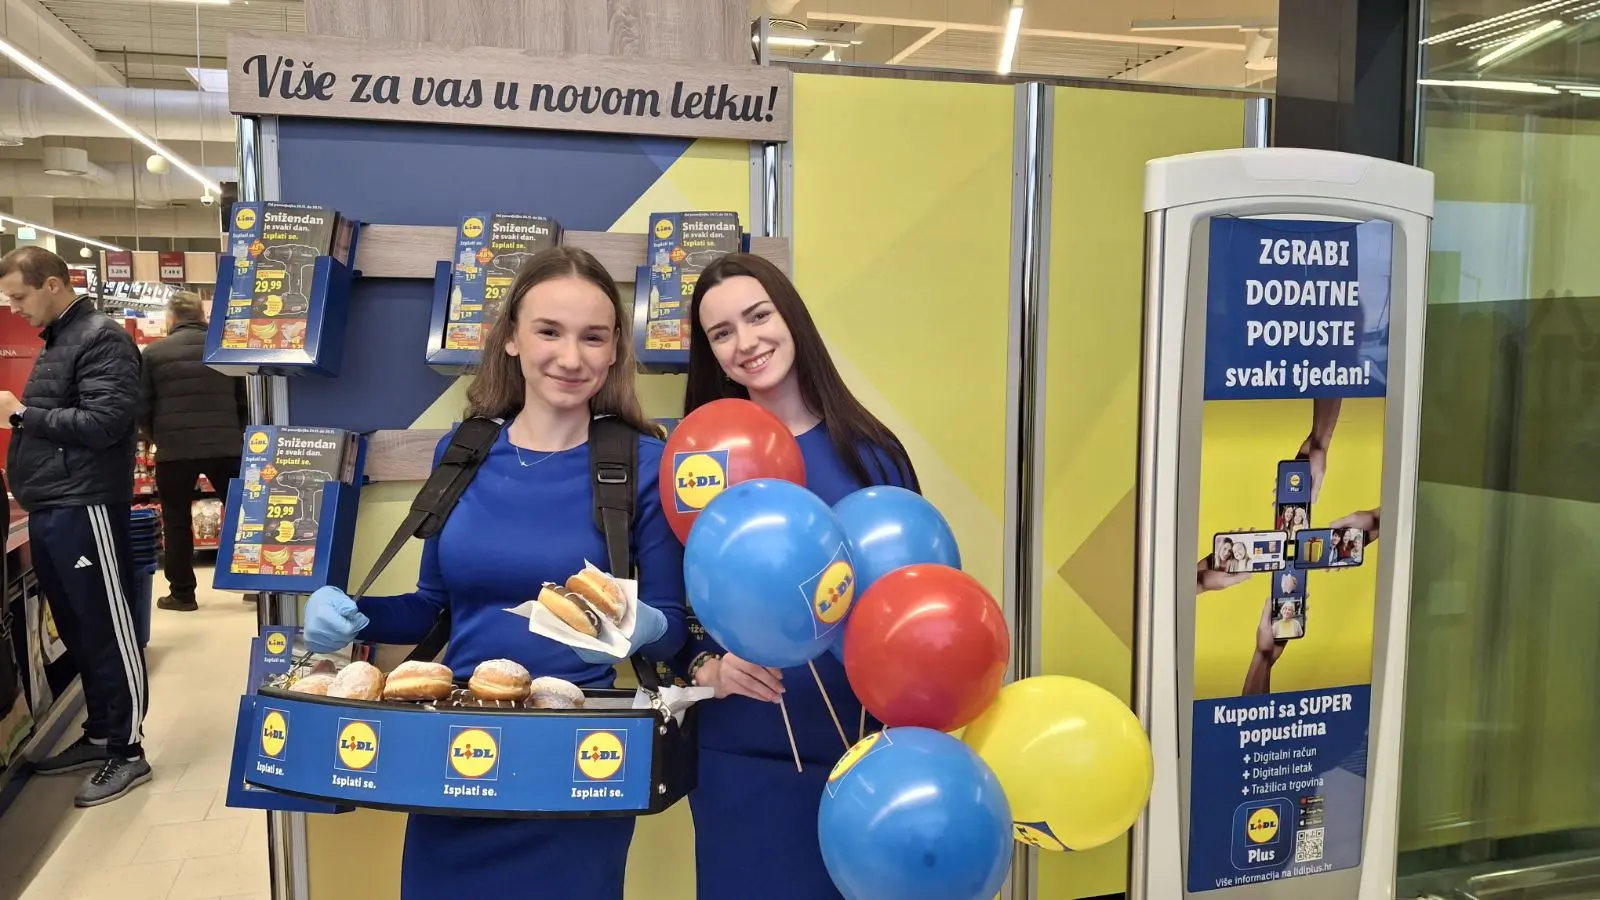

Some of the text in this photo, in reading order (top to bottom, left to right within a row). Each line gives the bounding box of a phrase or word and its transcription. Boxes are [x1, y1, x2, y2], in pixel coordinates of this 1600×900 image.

[242, 54, 778, 123] Više za vas u novom letku!
[264, 212, 324, 225] Snižendan
[263, 223, 270, 231] je
[272, 223, 291, 231] svaki
[493, 223, 549, 235] Snižendan
[682, 221, 736, 231] Snižendan
[263, 233, 287, 241] Isplati
[683, 240, 705, 248] Isplati
[492, 241, 515, 249] Isplati
[1259, 238, 1350, 267] ZGRABI
[1246, 279, 1360, 306] DODATNE
[1247, 320, 1355, 347] POPUSTE
[1225, 360, 1370, 393] svaki tjedan!
[277, 437, 336, 449] Snižendan
[276, 448, 283, 456] je
[285, 448, 305, 456] svaki
[275, 458, 300, 466] Isplati
[1214, 693, 1353, 726] Kuponi sa SUPER
[1239, 719, 1327, 748] popustima
[1253, 751, 1291, 765] Digitalni
[1293, 746, 1317, 758] račun
[256, 761, 284, 776] Isplati se.
[1252, 767, 1290, 781] Digitalni
[1292, 762, 1313, 774] letak
[332, 774, 376, 789] Isplati se.
[1252, 782, 1287, 795] Tražilica
[1289, 777, 1324, 792] trgovina
[444, 784, 497, 797] Isplati se.
[571, 787, 624, 799] Isplati se.
[1248, 849, 1275, 863] Plus
[1216, 875, 1232, 888] Više
[1234, 870, 1280, 885] informacija
